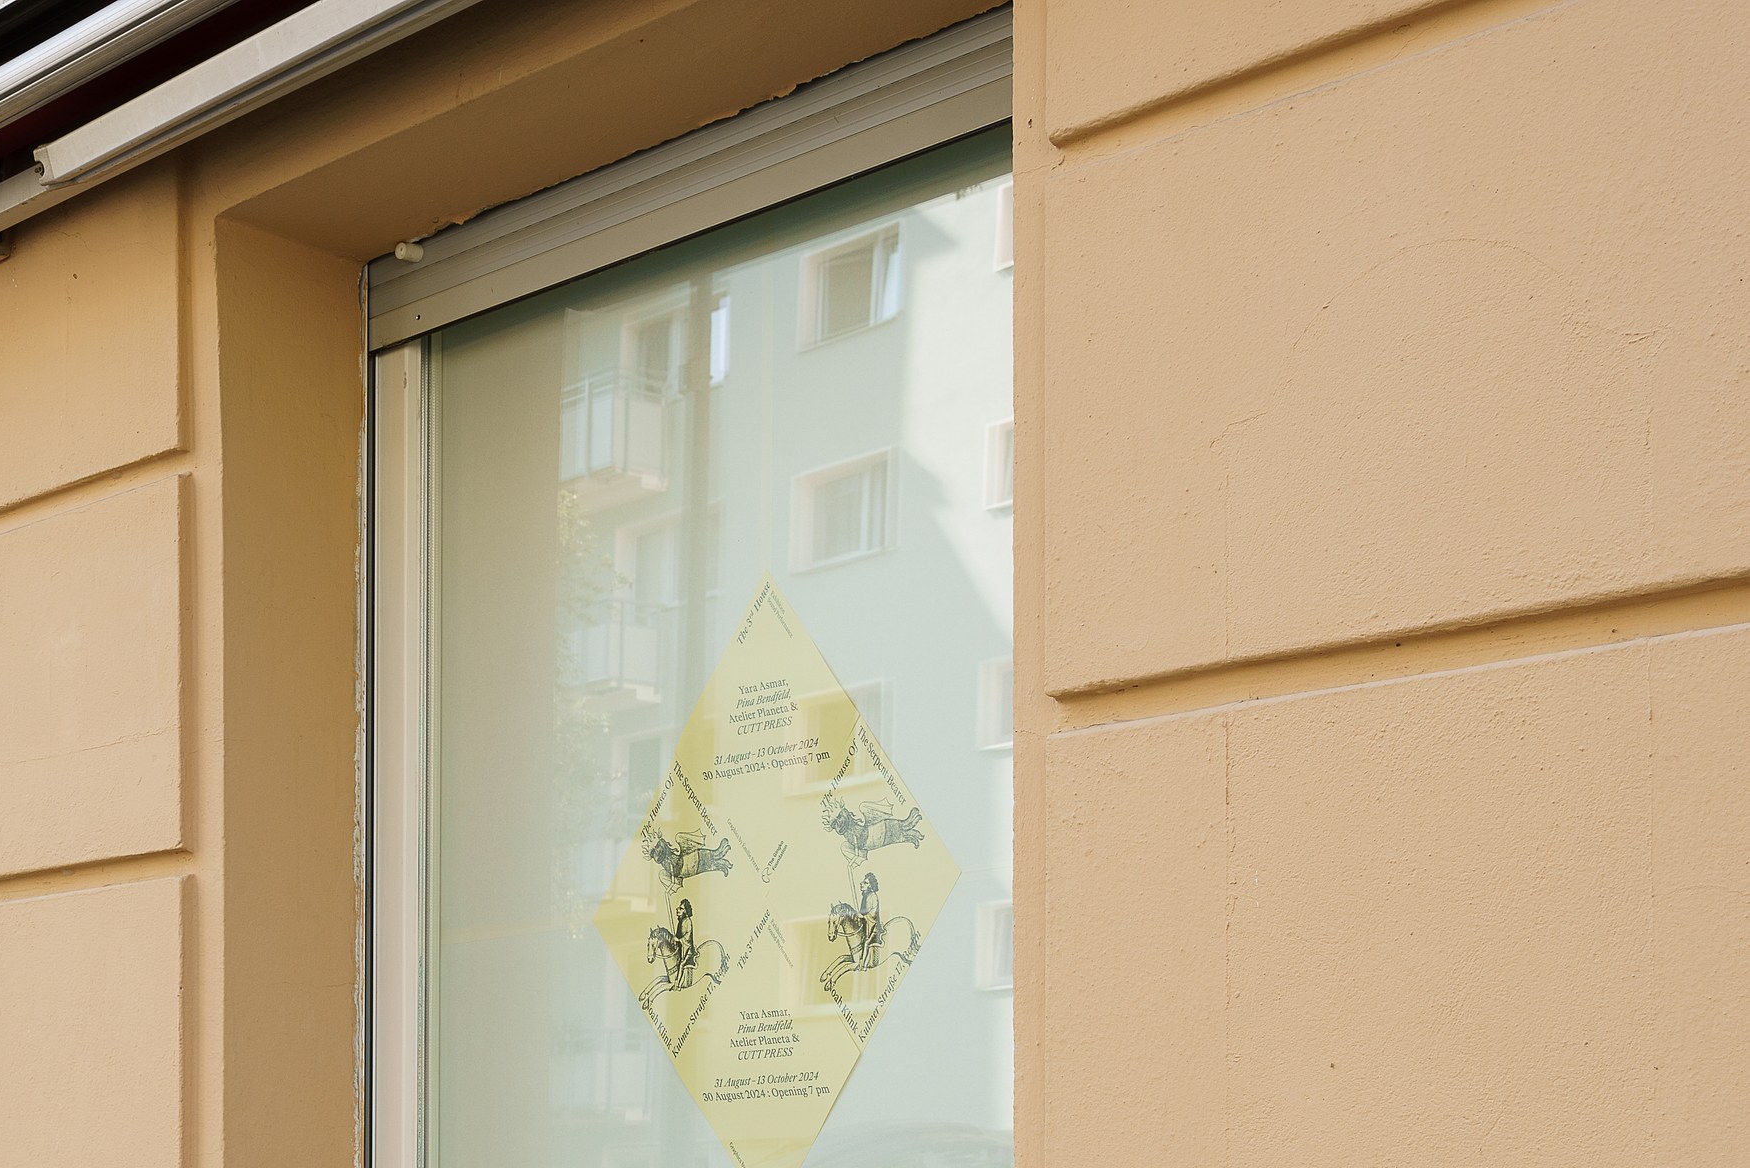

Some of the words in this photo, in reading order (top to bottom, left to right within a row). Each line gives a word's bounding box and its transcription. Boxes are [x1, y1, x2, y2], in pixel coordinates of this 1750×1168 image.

[736, 626, 749, 645] The
[754, 581, 770, 612] House
[736, 698, 754, 709] Pina
[756, 689, 791, 706] Bendfeld,
[739, 685, 758, 695] Yara
[760, 679, 789, 691] Asmar,
[729, 710, 756, 724] Atelier
[757, 705, 789, 718] Planeta
[790, 702, 799, 711] &
[737, 722, 763, 736] CUTT
[763, 716, 793, 730] PRESS
[702, 771, 714, 781] 30
[715, 767, 745, 779] August
[746, 762, 766, 773] 2024
[771, 755, 808, 769] Opening
[815, 751, 831, 763] pm
[714, 756, 723, 766] 31
[724, 751, 752, 764] August
[756, 749, 766, 758] 13
[767, 743, 798, 756] October
[798, 738, 819, 749] 2024
[857, 725, 869, 747] The
[867, 742, 907, 806] Serpent-Bearer
[820, 790, 833, 808] The
[831, 756, 851, 790] Houses
[848, 738, 859, 756] Of
[641, 821, 652, 839] The
[650, 791, 667, 822] Houses
[665, 773, 675, 790] Of
[673, 761, 684, 782] The
[682, 777, 718, 836] Serpent-Bearer
[736, 951, 749, 970] The
[754, 909, 770, 939] House
[740, 1011, 759, 1021] Yara
[761, 1009, 791, 1018] Asmar,
[858, 1005, 880, 1043] Kulmer
[878, 976, 897, 1008] Straße
[895, 961, 906, 976] 17,
[671, 1023, 691, 1058] Kulmer
[690, 994, 708, 1025] Straße
[706, 982, 716, 996] 17,
[737, 1024, 756, 1034] Pina
[757, 1019, 793, 1033] Bendfeld,
[841, 1004, 859, 1034] Klink
[657, 1022, 672, 1051] Klink
[730, 1037, 757, 1048] Atelier
[758, 1035, 790, 1046] Planeta
[791, 1033, 800, 1042] &
[738, 1049, 764, 1060] CUTT
[764, 1046, 794, 1059] PRESS
[702, 1092, 714, 1102] 30
[715, 1091, 745, 1103] August
[746, 1089, 766, 1099] 2024
[771, 1086, 808, 1099] Opening
[815, 1085, 831, 1098] pm
[714, 1078, 723, 1088] 31
[724, 1077, 752, 1089] August
[756, 1075, 766, 1085] 13
[767, 1072, 798, 1085] October
[798, 1071, 819, 1082] 2024
